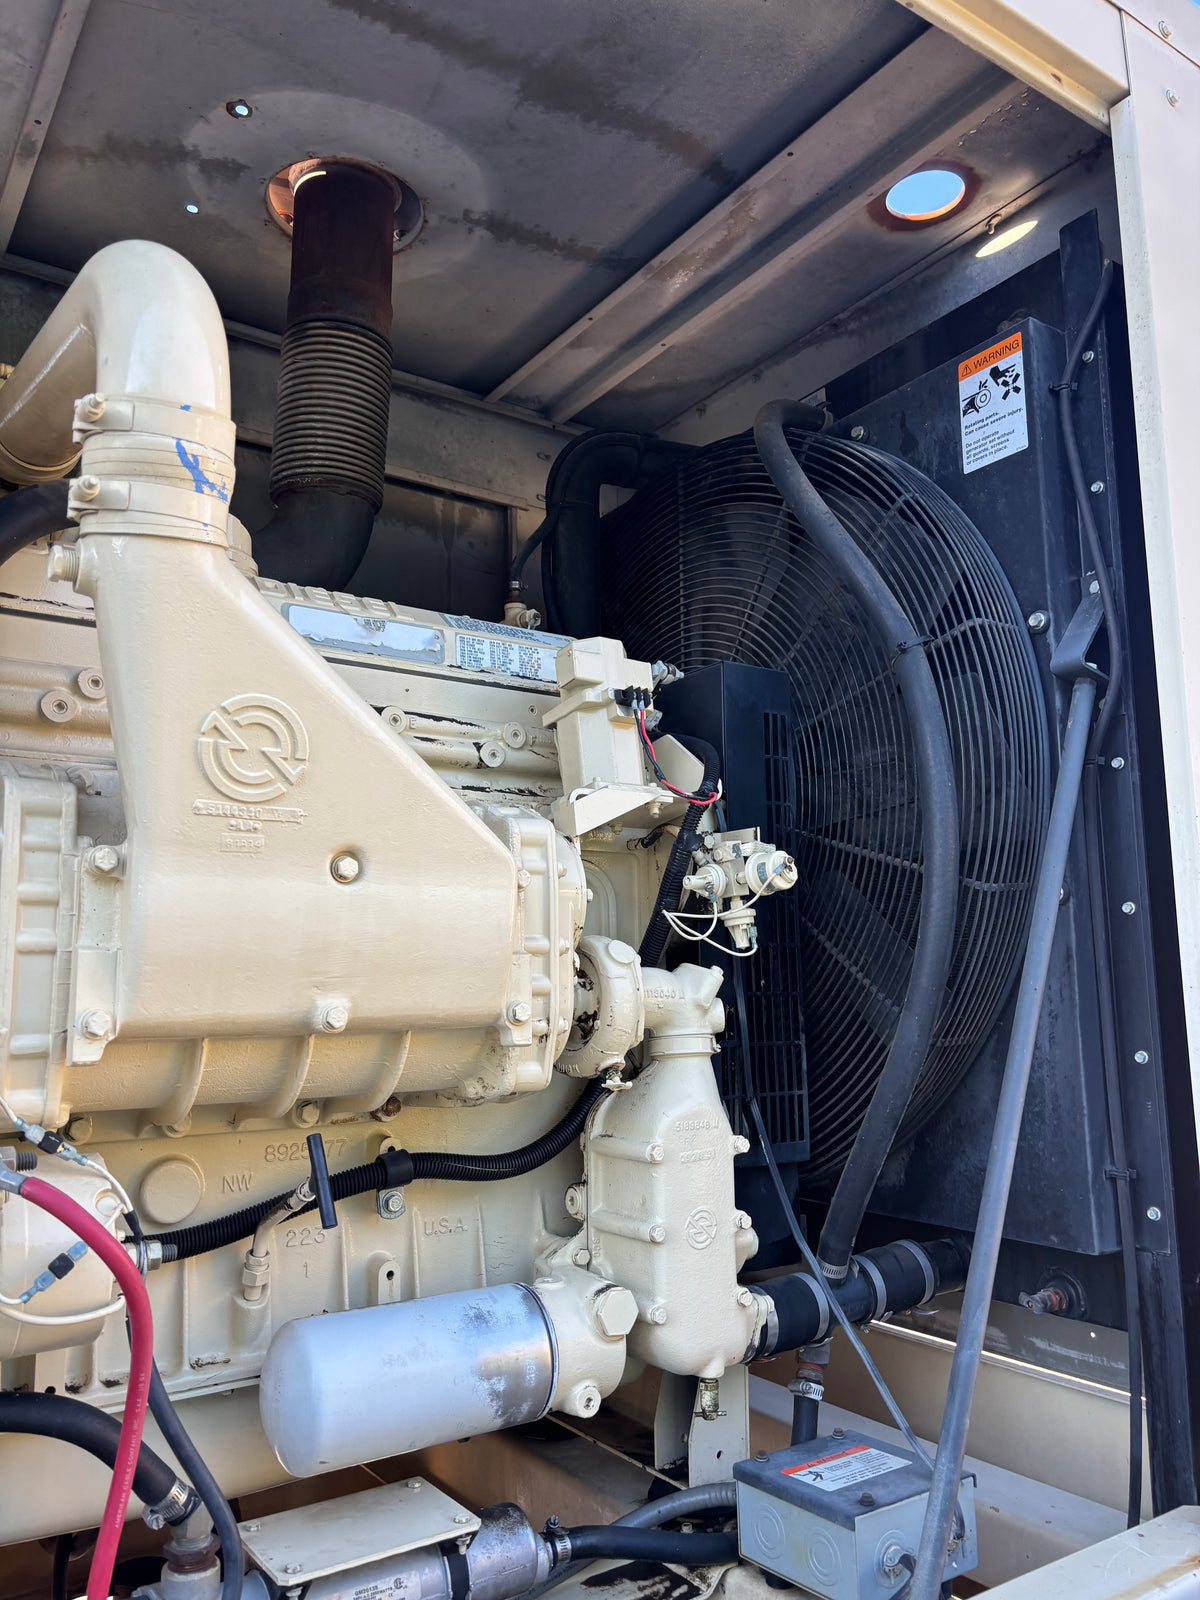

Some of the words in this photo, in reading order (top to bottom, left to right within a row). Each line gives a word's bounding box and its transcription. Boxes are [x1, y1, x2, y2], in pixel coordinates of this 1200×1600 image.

[973, 339, 1020, 369] WARNING
[964, 418, 985, 430] Rotating
[974, 422, 989, 431] cause
[990, 415, 1006, 424] severe
[981, 430, 999, 441] operate
[253, 576, 415, 621] DIESEL
[264, 1138, 349, 1163] 892577
[221, 1172, 254, 1194] NW
[423, 1216, 469, 1237] U.S.A.
[114, 1490, 127, 1529] AMERICAN
[122, 1465, 132, 1490] CABLE
